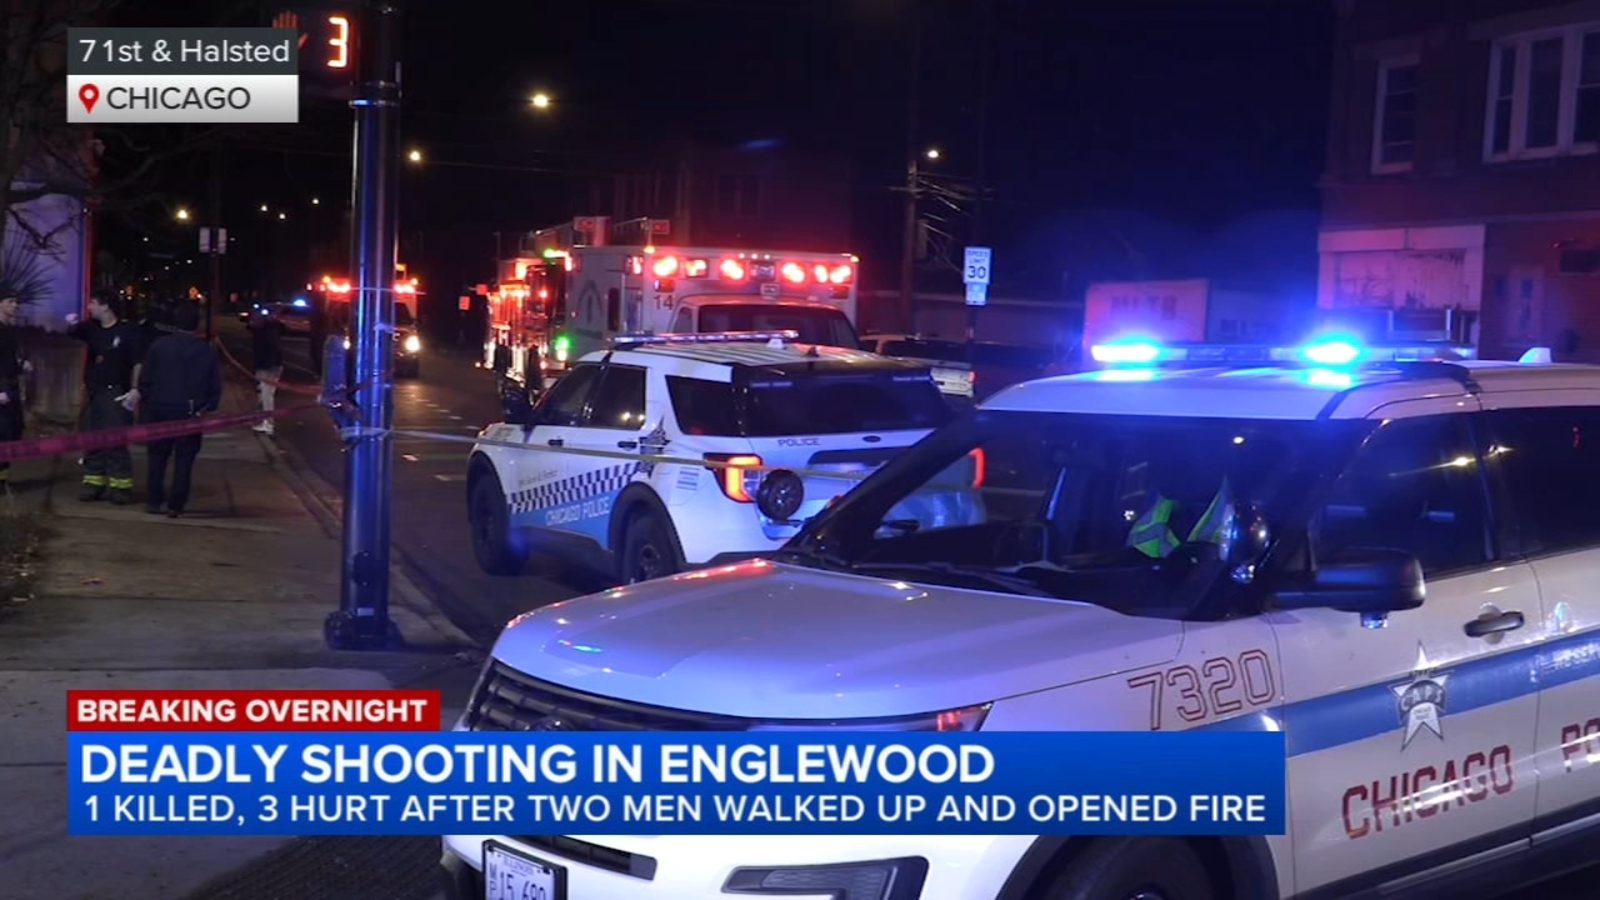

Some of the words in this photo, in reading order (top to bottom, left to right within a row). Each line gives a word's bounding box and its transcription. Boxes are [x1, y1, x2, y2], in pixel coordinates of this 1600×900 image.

[327, 16, 349, 68] 3
[967, 265, 987, 279] 30
[653, 293, 674, 311] 14
[777, 437, 821, 448] POLICE
[1126, 648, 1276, 731] 7320
[1341, 743, 1515, 840] CHICAGO
